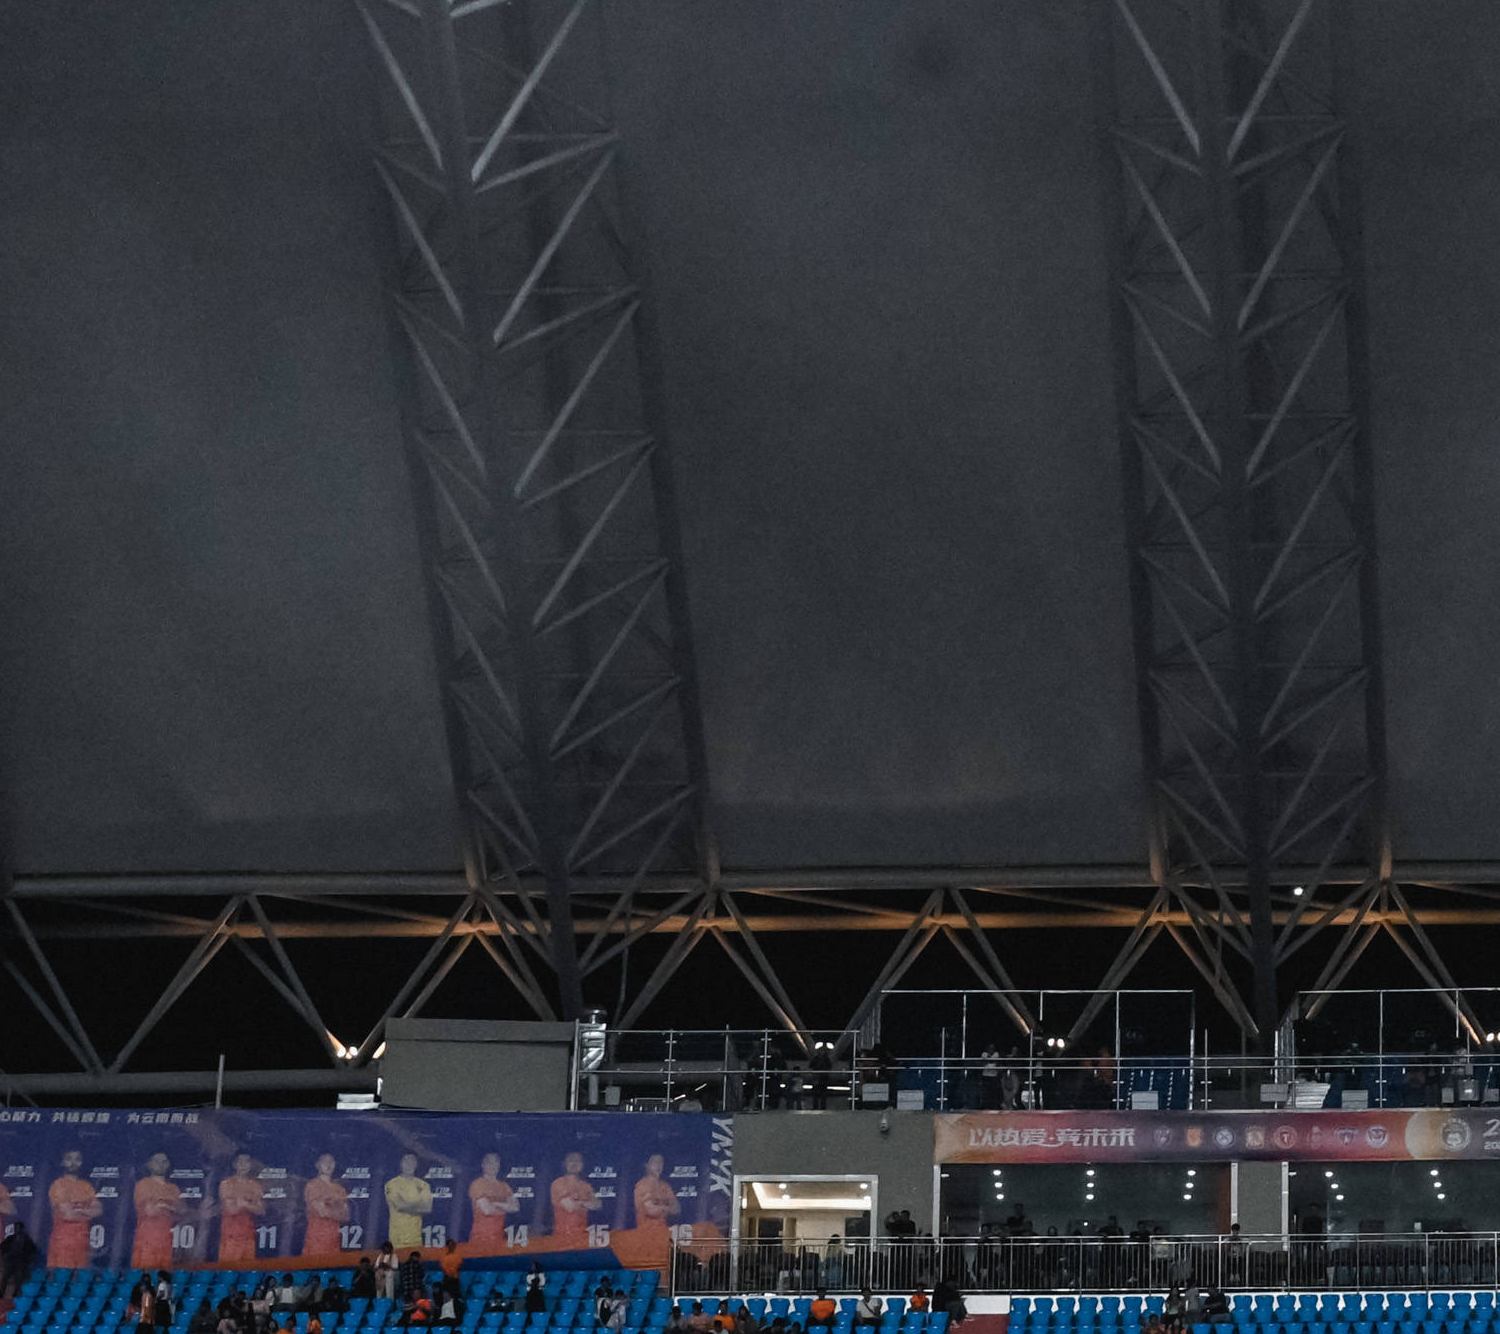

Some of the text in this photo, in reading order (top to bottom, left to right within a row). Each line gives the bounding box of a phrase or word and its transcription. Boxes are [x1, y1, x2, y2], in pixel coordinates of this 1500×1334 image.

[90, 1224, 105, 1248] 9
[171, 1224, 196, 1248] 10
[256, 1225, 277, 1249] 11
[340, 1225, 364, 1249] 12
[422, 1224, 446, 1248] 13
[504, 1224, 528, 1248] 14
[586, 1224, 610, 1248] 15
[669, 1223, 692, 1247] 16
